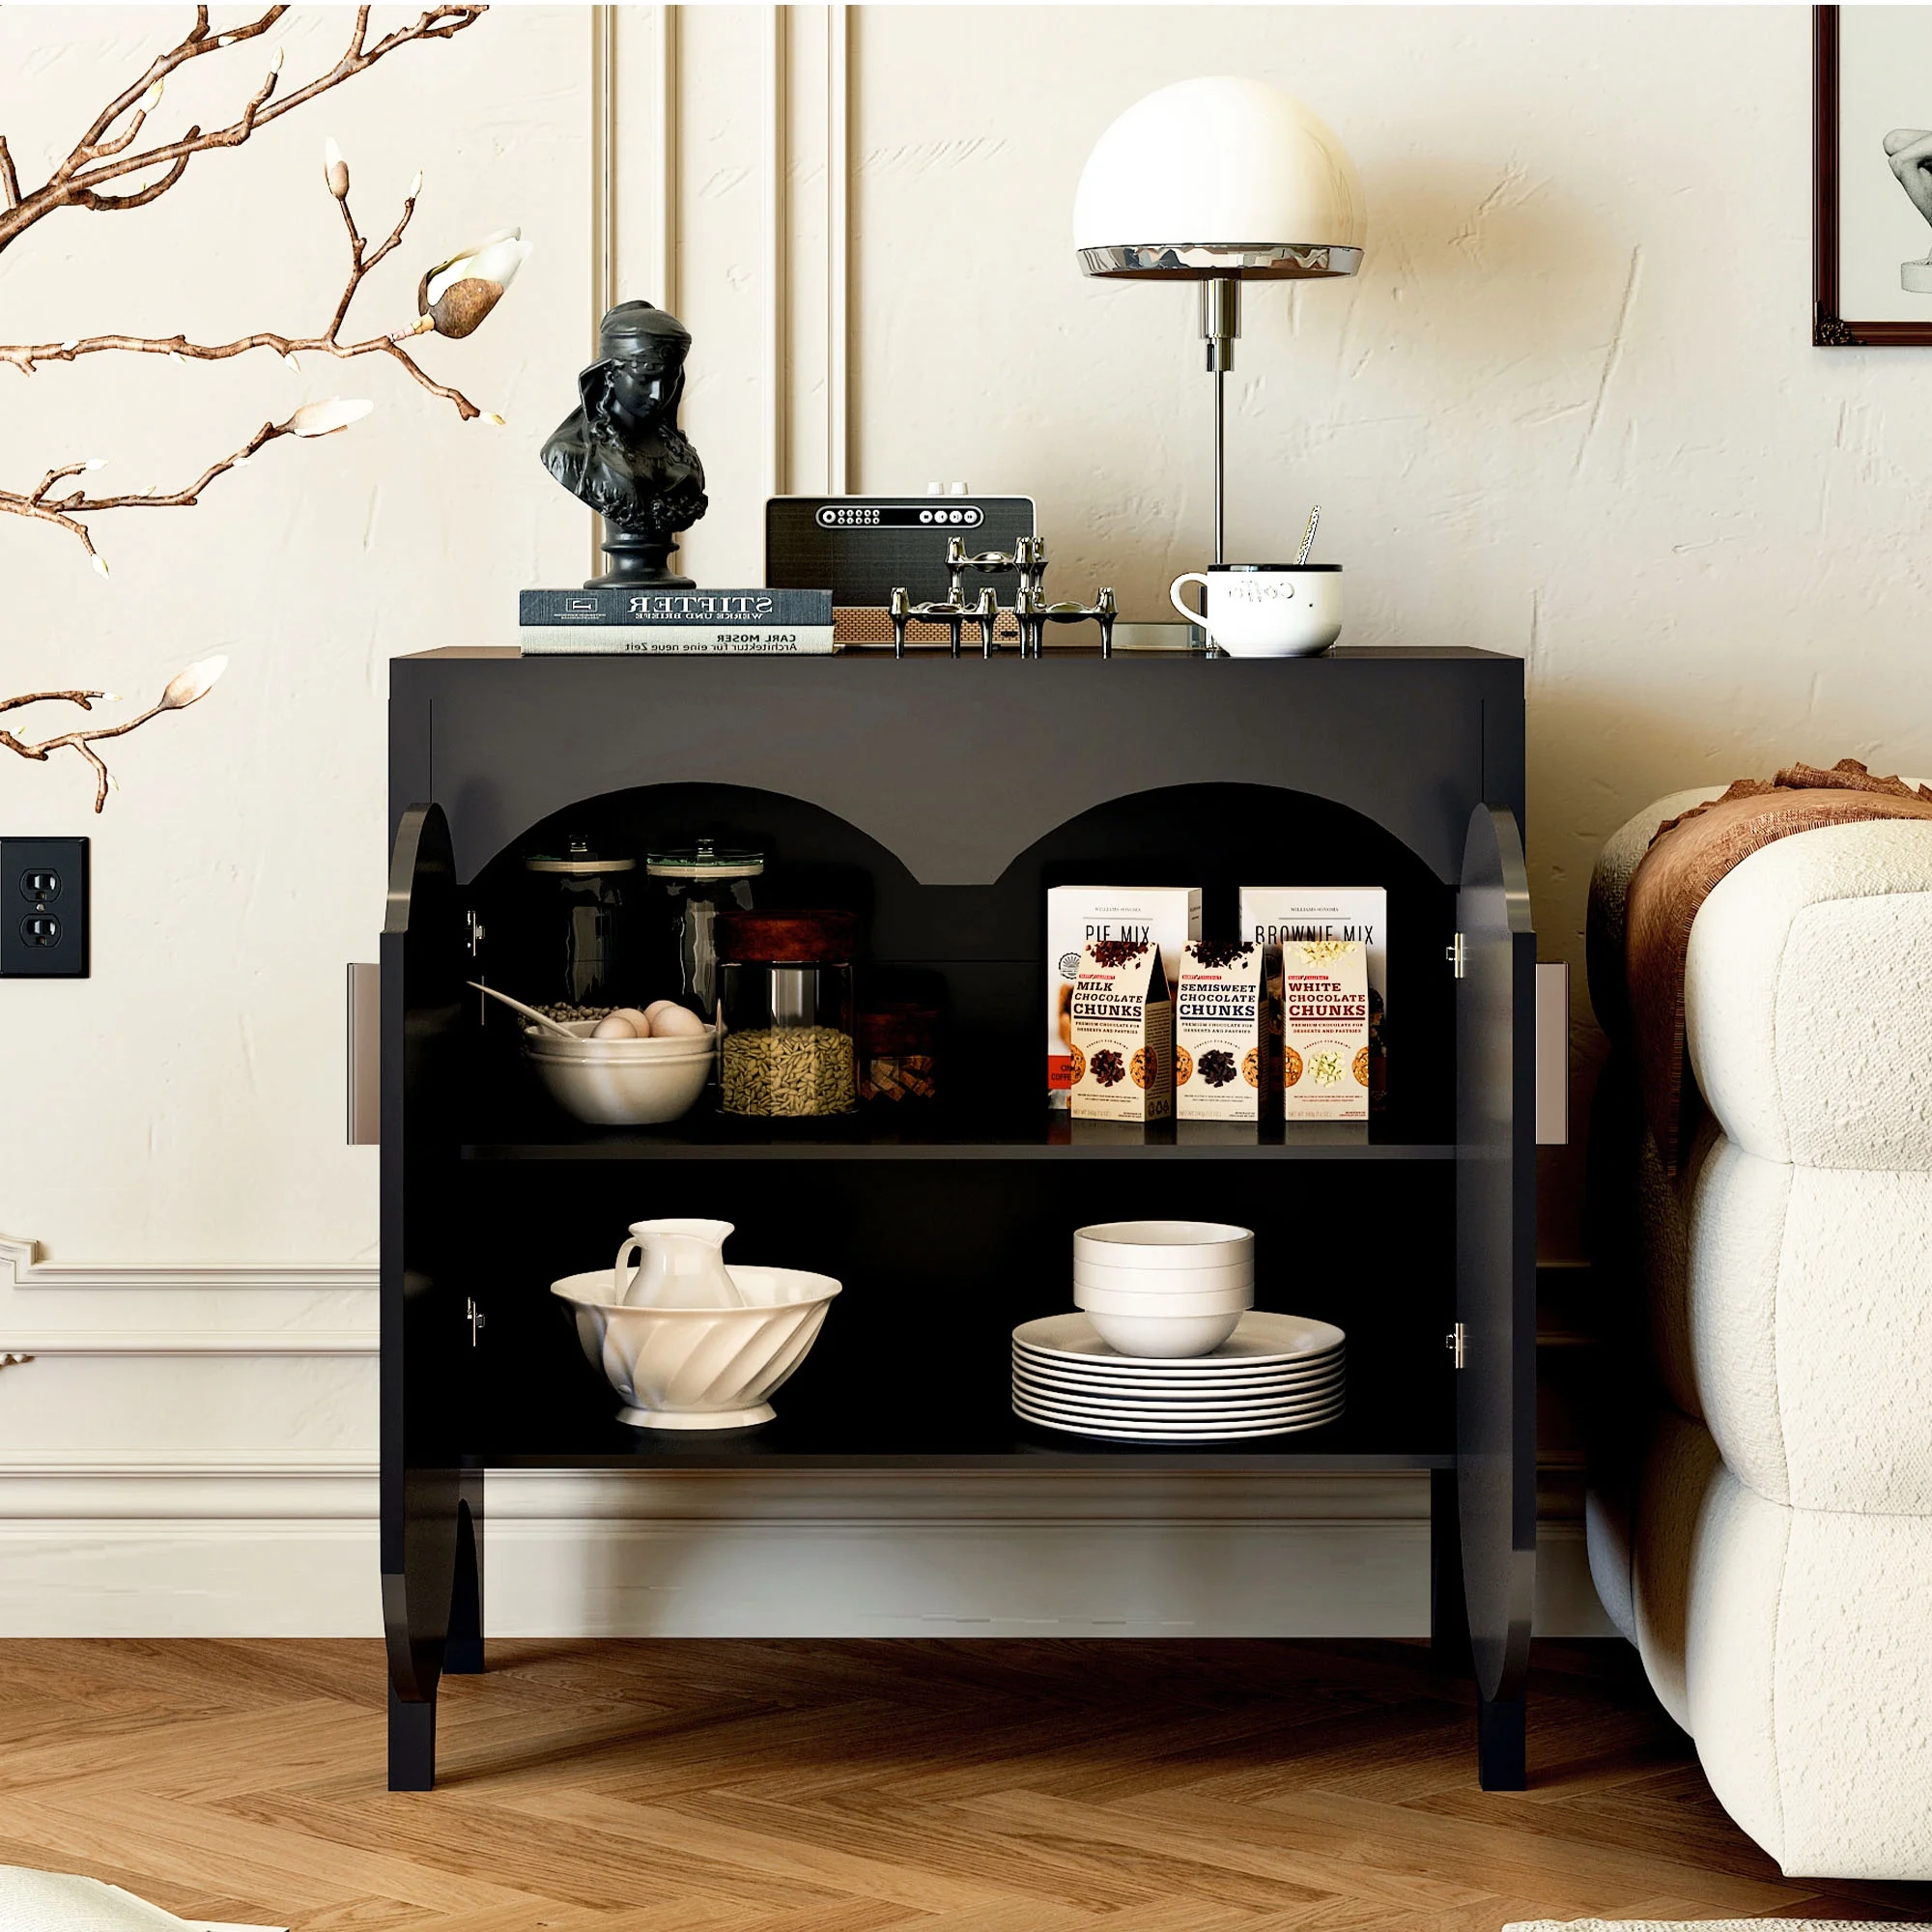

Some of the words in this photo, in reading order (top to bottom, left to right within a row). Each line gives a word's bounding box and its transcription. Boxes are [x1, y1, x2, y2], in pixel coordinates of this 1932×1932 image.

[1121, 925, 1150, 944] MIX
[1344, 925, 1374, 945] MIX
[1077, 981, 1114, 992] MILK
[1180, 983, 1257, 992] SEMISWEET
[1288, 982, 1342, 992] WHITE
[1074, 993, 1144, 1003] CHOCOLATE
[1179, 993, 1256, 1003] CHOCOLATE
[1289, 994, 1366, 1003] CHOCOLATE
[1073, 1004, 1142, 1017] CHUNKS
[1179, 1004, 1255, 1016] CHUNKS
[1289, 1005, 1366, 1016] CHUNKS
